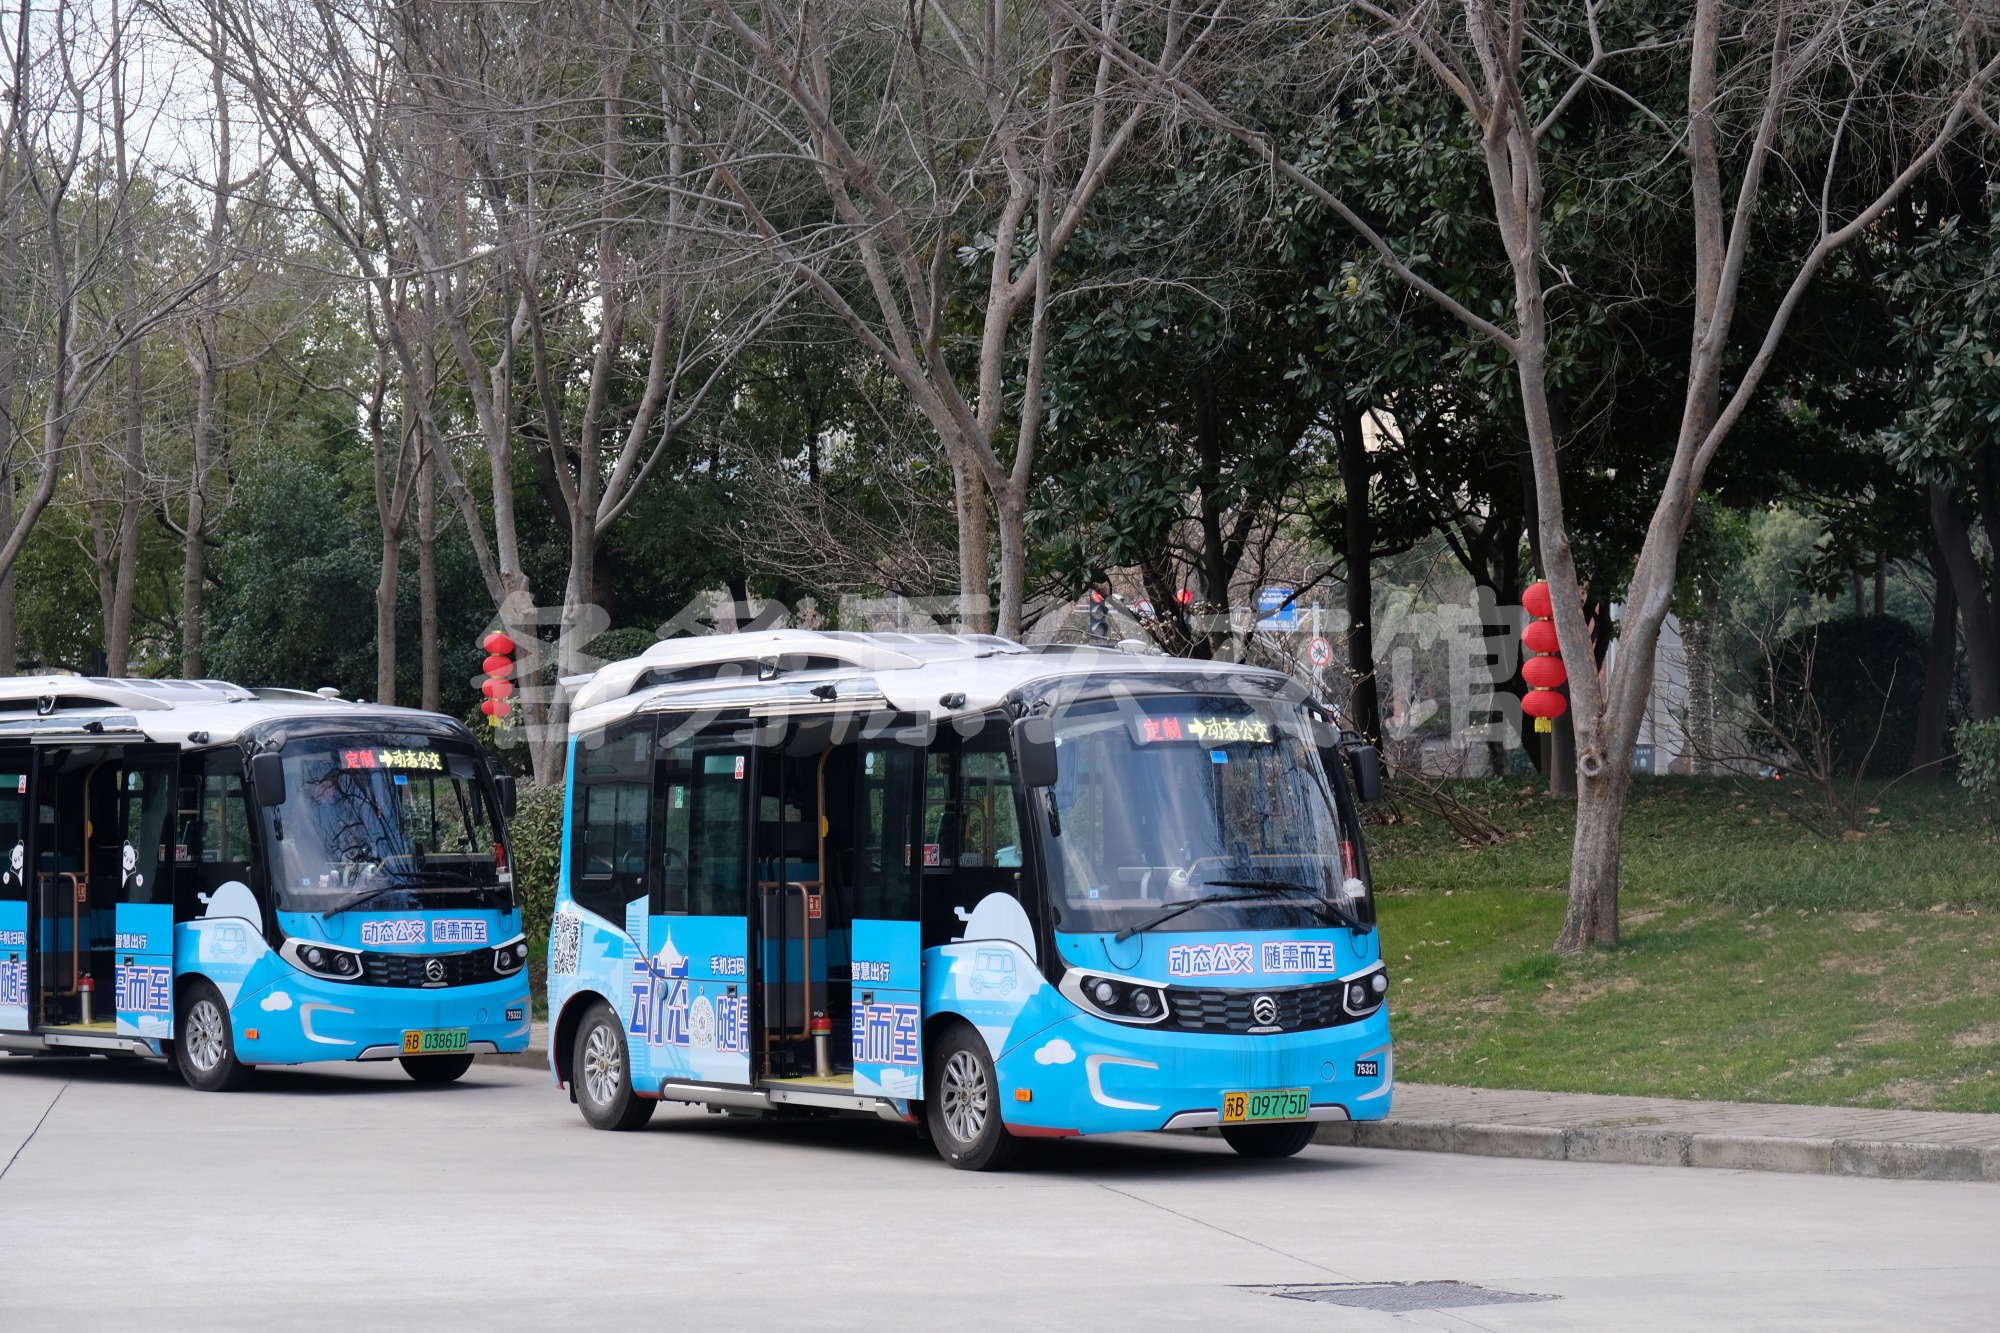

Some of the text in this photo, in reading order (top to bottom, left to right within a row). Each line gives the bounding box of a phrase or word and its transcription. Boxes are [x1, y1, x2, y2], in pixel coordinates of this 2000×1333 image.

[1143, 717, 1273, 743] 定制 动态公交
[345, 749, 443, 770] 定制 动态公交
[115, 934, 147, 950] 智慧出行
[363, 921, 486, 943] 动态公交 随需而至
[710, 956, 745, 975] 手机扫码
[1171, 945, 1333, 974] 动态公交 随需而至
[852, 961, 890, 982] 智慧出行
[507, 1010, 522, 1019] 75322
[424, 1032, 467, 1049] 03861D
[1356, 1063, 1377, 1075] 75321
[1226, 1094, 1307, 1117] 苏B 09775D
